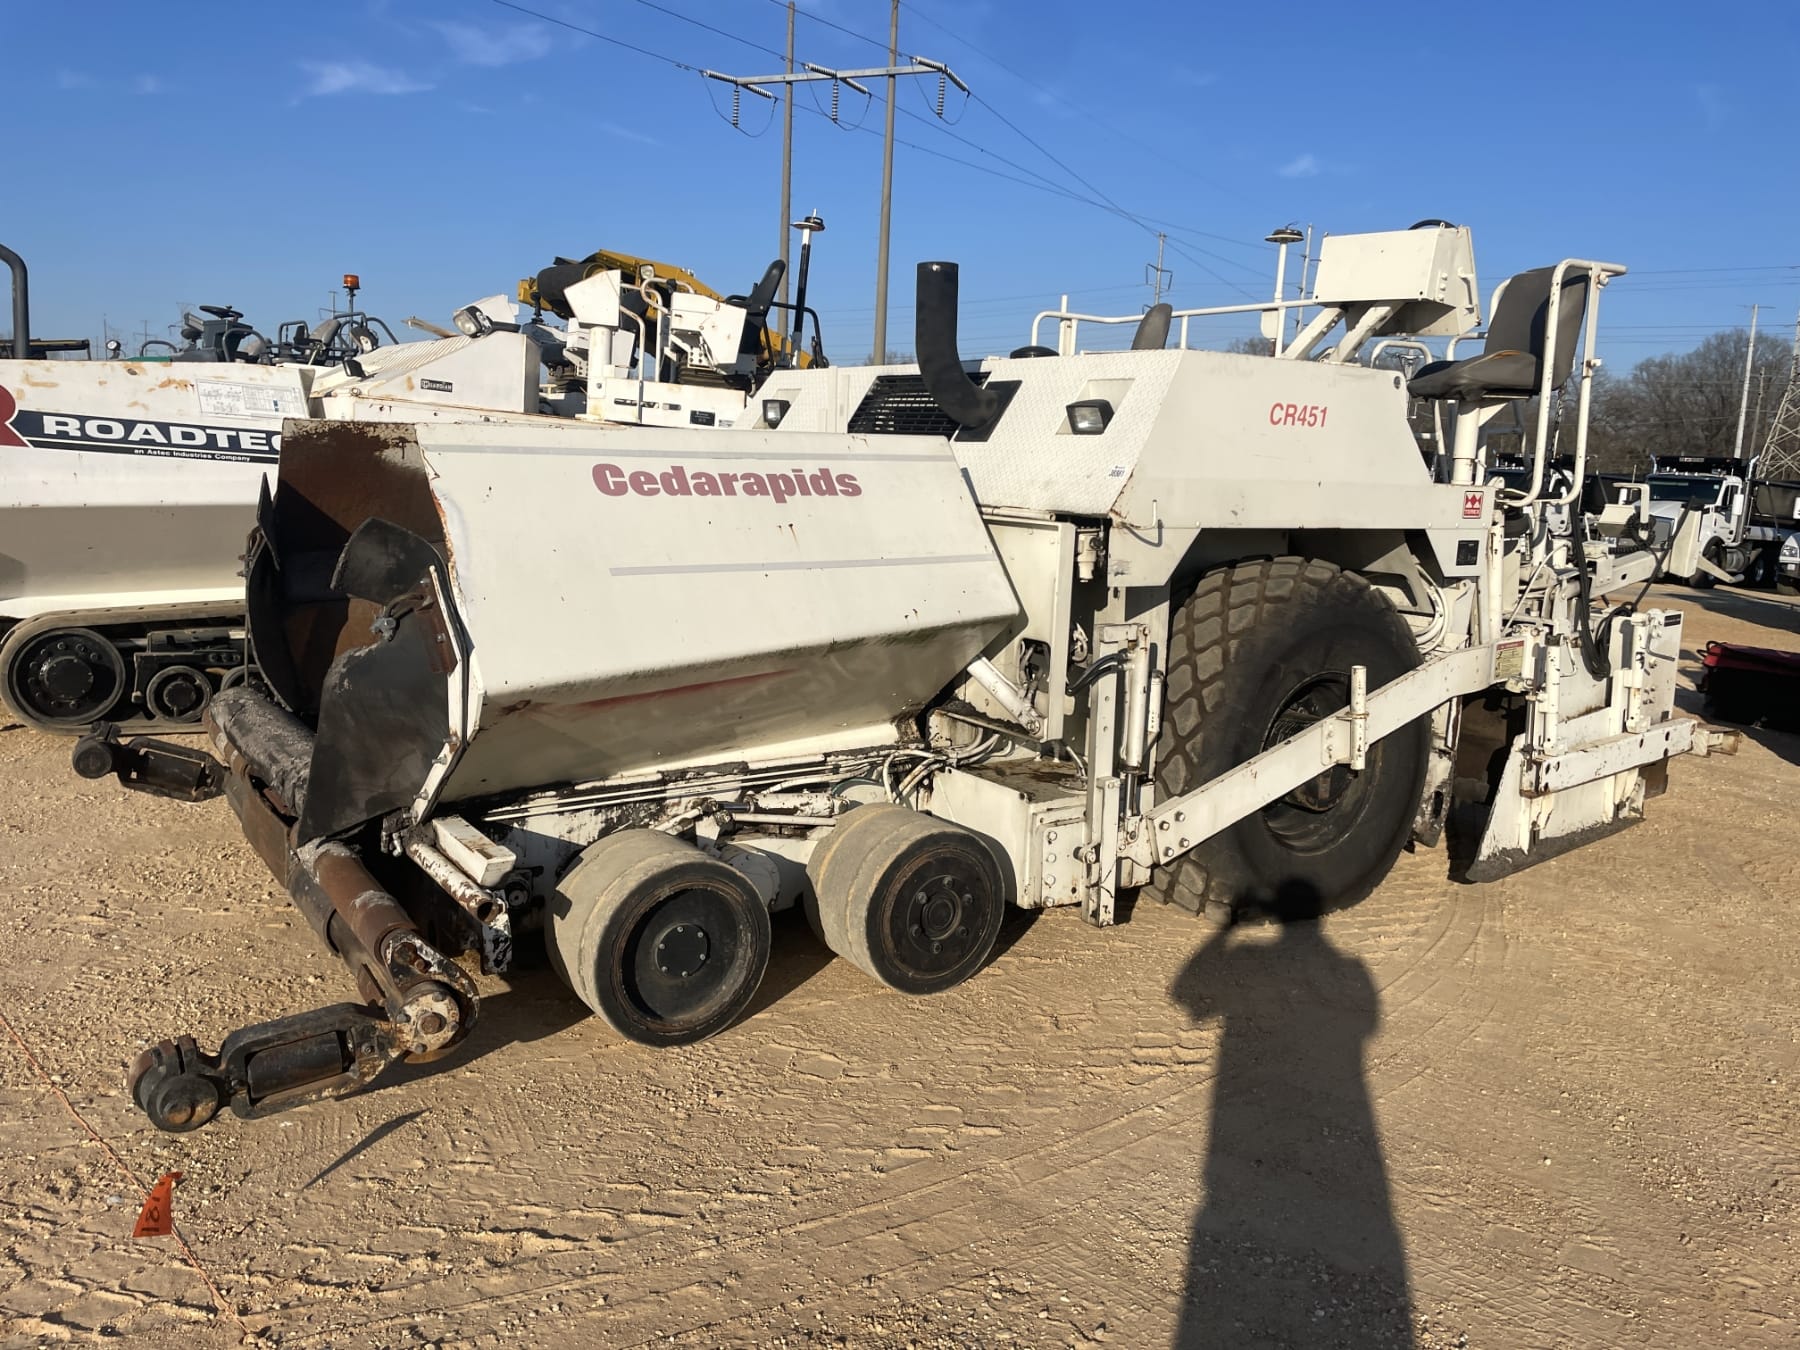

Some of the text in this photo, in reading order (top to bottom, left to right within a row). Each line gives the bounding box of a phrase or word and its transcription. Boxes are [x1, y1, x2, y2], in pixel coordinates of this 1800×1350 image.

[1269, 402, 1328, 428] CR451
[43, 415, 281, 451] ROADTE
[147, 449, 171, 457] Astec
[173, 451, 213, 459] Industries
[214, 453, 250, 462] Company
[592, 463, 863, 504] Cedarapids
